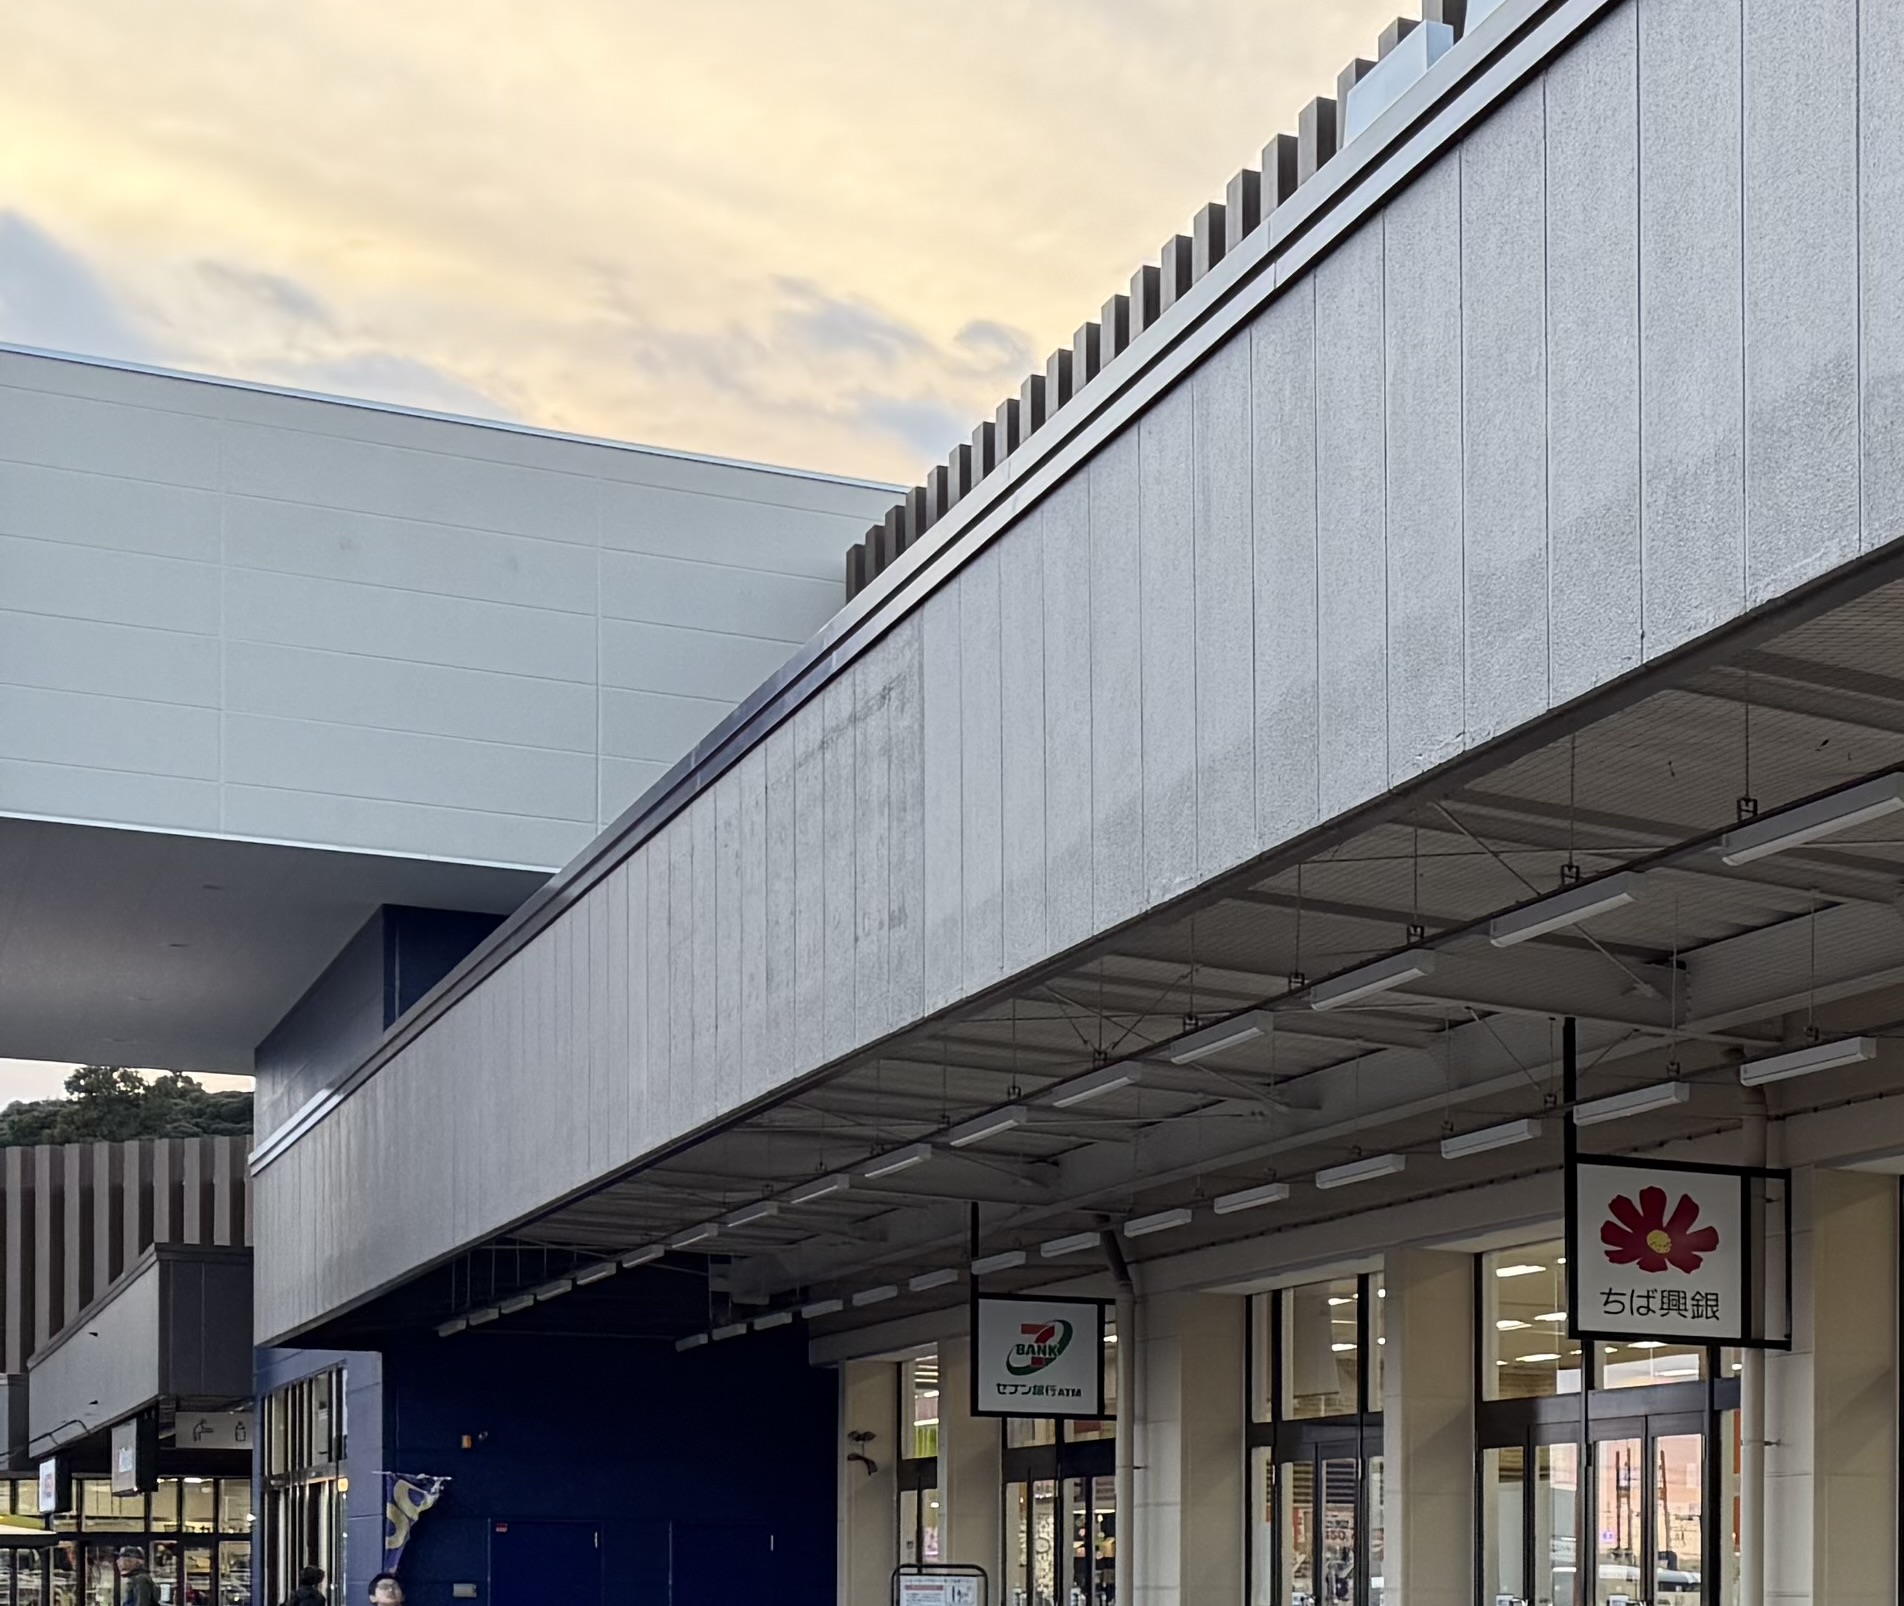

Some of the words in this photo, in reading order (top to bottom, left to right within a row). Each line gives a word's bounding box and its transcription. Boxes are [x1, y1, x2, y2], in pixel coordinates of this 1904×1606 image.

[1600, 1287, 1720, 1321] ちば興銀
[1015, 1343, 1061, 1357] BANK
